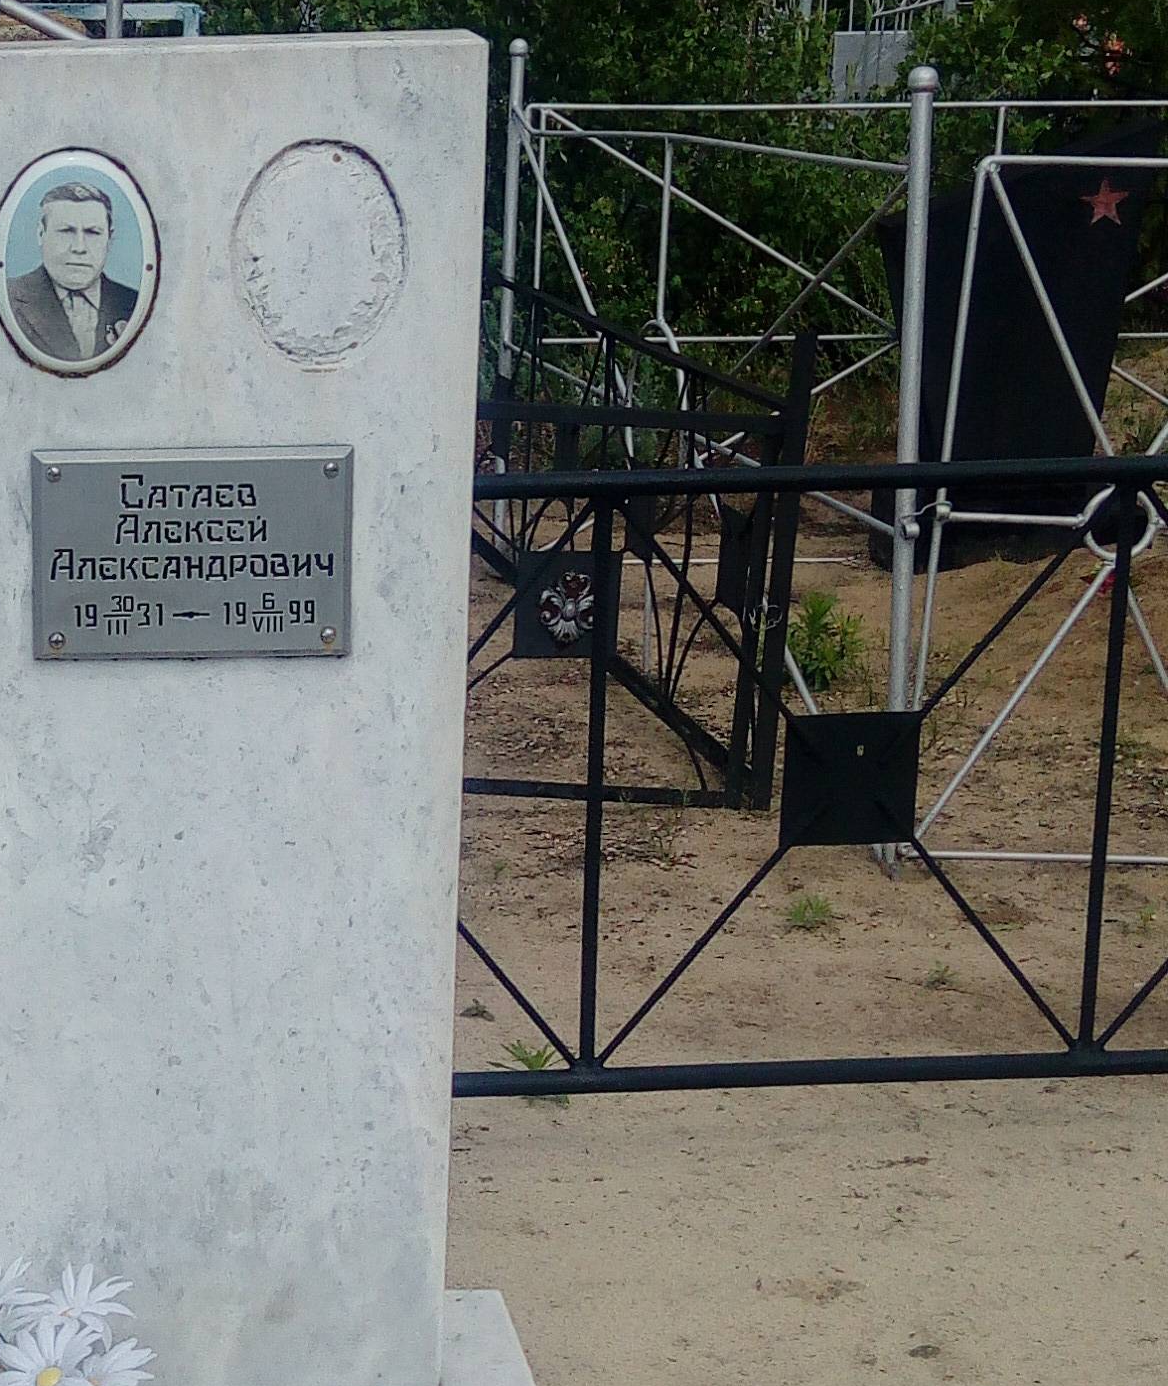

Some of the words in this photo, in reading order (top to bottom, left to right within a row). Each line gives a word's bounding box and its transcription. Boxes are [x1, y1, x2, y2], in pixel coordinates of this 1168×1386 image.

[120, 474, 257, 509] САТАЕВ
[115, 514, 268, 544] АЛЕКСЕЙ
[50, 548, 334, 581] АЛЕКСАНДРОВИЧ
[74, 604, 97, 627] 19
[137, 603, 164, 626] 31
[223, 601, 247, 625] 19
[289, 599, 316, 624] 99
